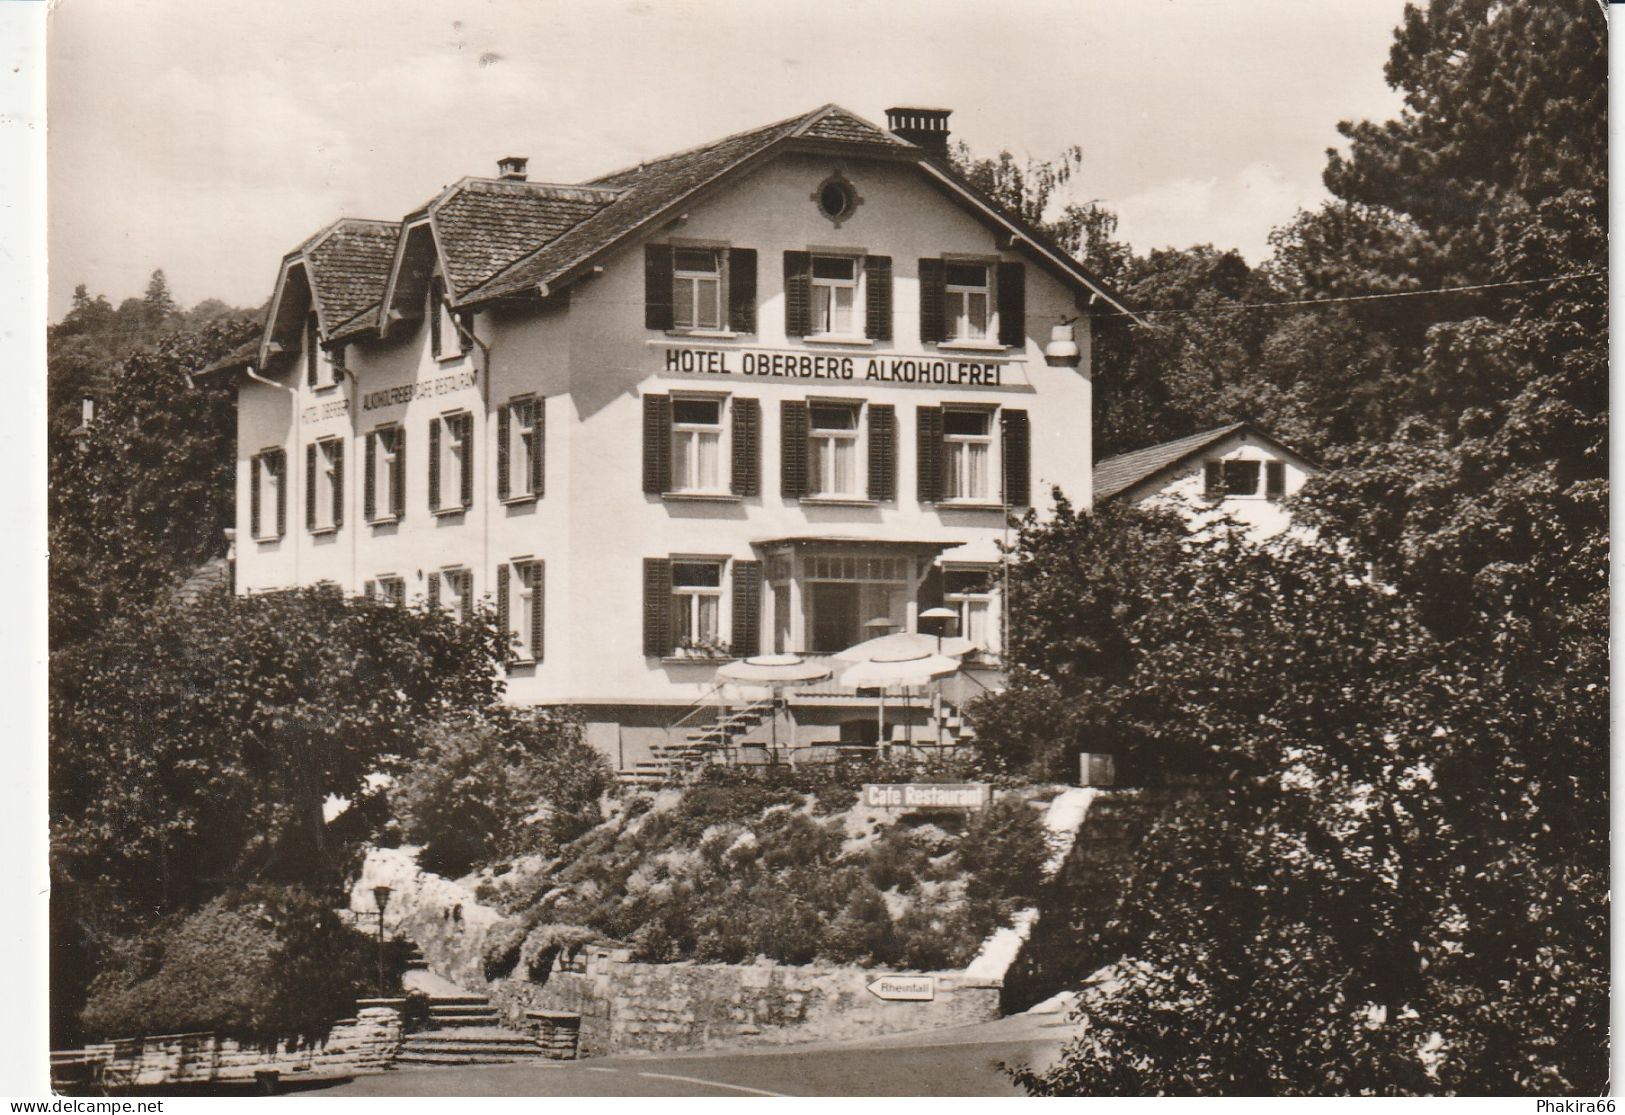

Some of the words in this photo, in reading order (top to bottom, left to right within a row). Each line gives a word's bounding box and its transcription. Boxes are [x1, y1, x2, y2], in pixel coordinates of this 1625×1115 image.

[665, 349, 731, 374] HOTEL
[742, 353, 854, 380] OBERBERG
[865, 360, 1000, 387] ALKOHOLFREI
[869, 786, 901, 805] Cafe
[905, 786, 983, 805] Restaurant
[881, 982, 929, 993] Rheinfall
